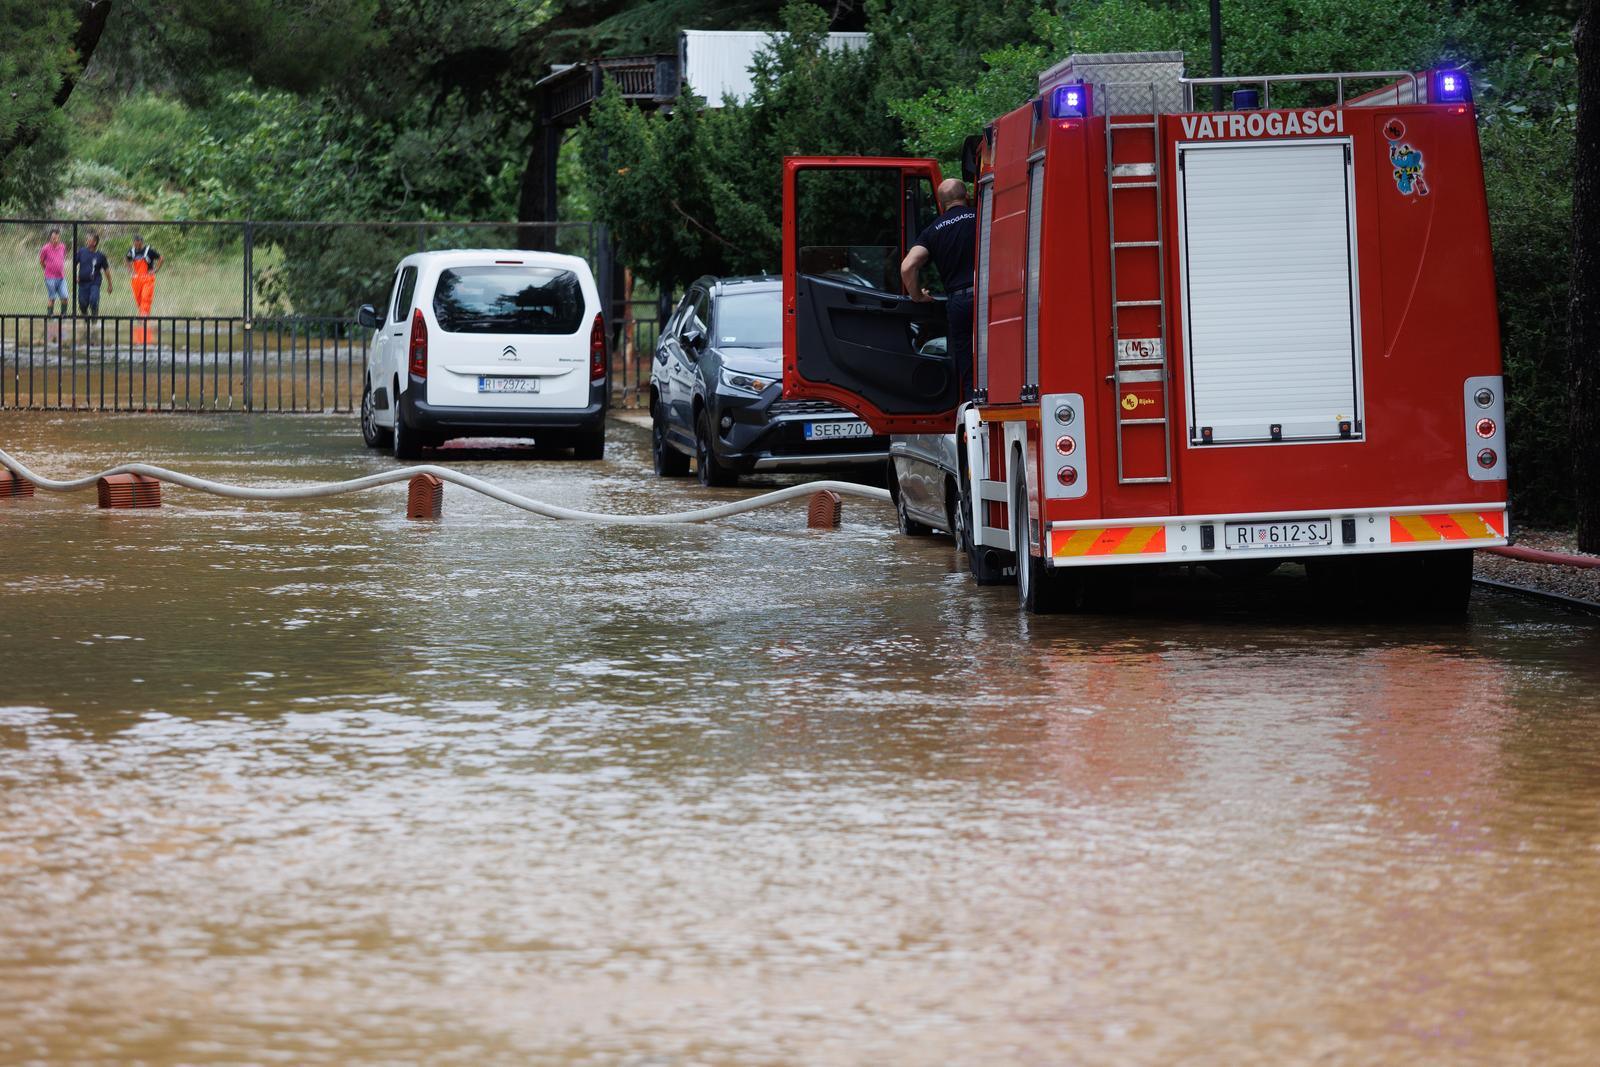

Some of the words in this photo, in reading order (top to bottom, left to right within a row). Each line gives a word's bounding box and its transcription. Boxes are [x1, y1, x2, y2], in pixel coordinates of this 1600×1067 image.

[1180, 110, 1344, 139] VATROGASCI
[935, 213, 976, 230] VATROGASCI
[1237, 527, 1254, 543] RI
[1269, 523, 1328, 542] 612-SJ
